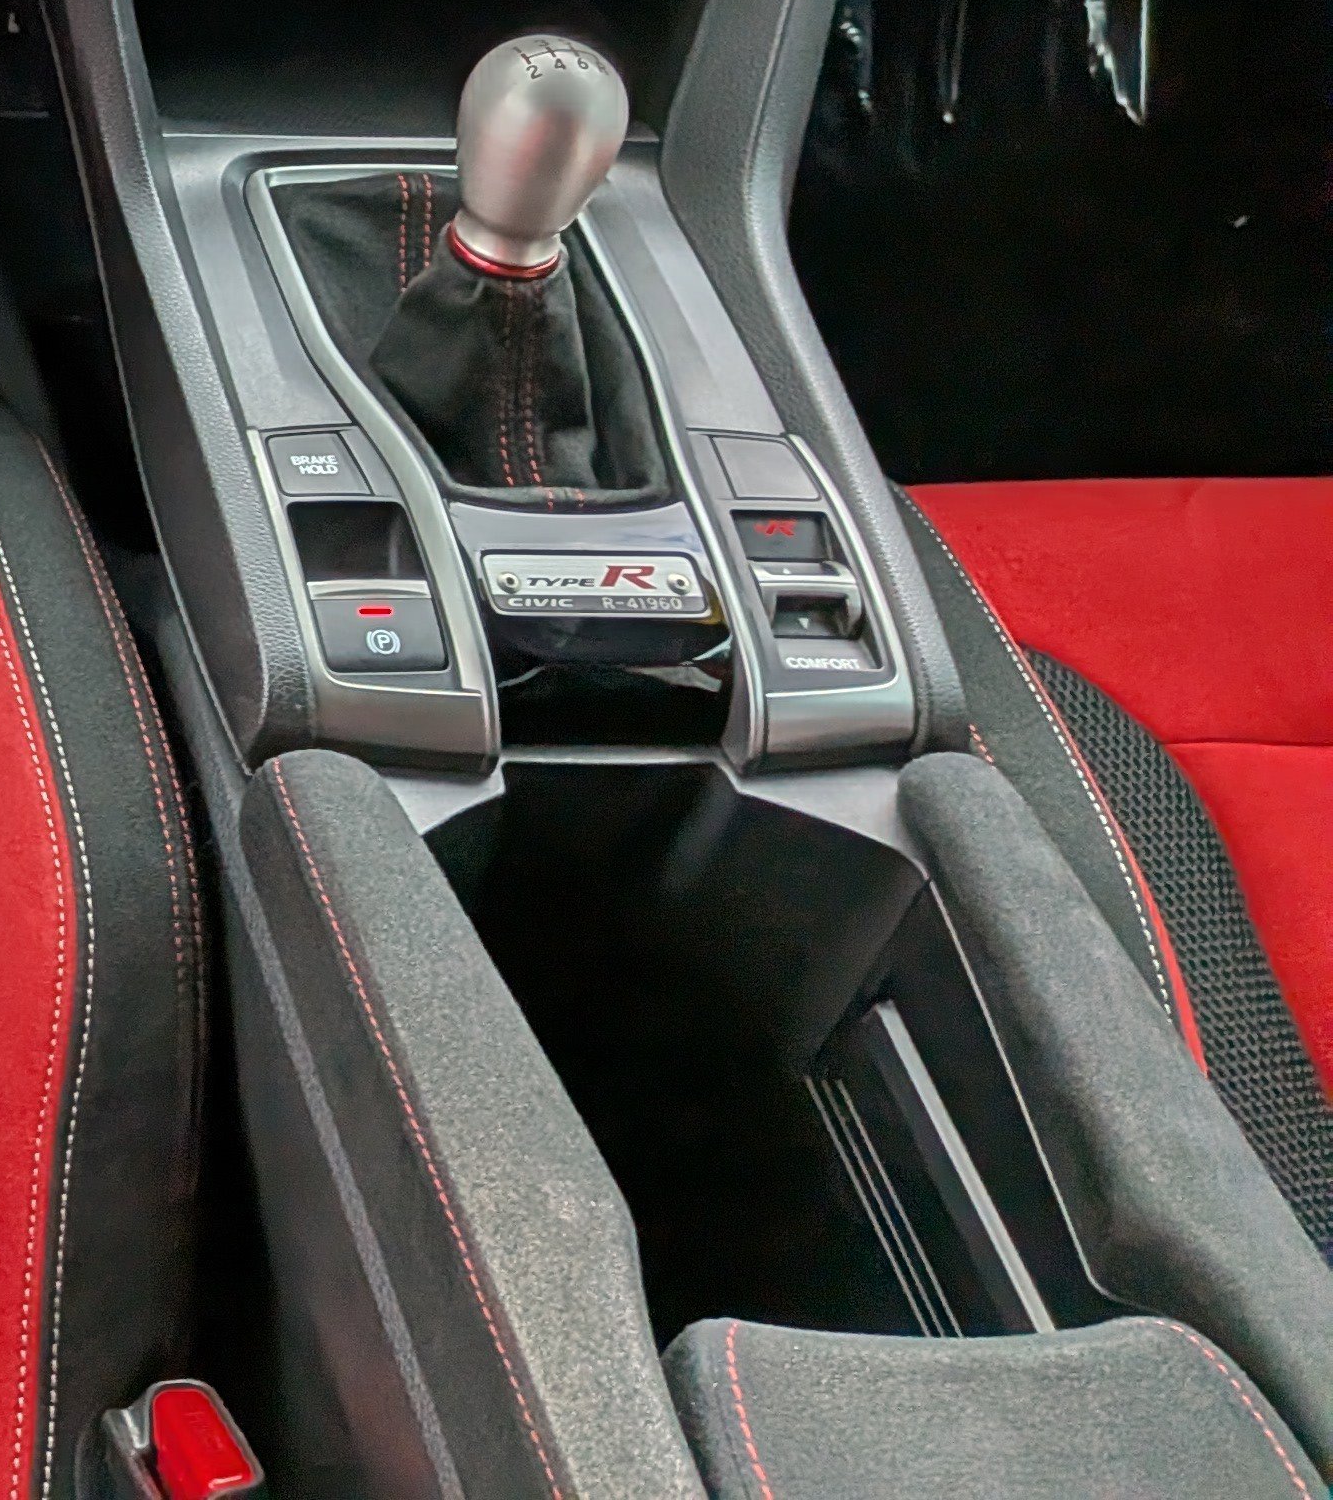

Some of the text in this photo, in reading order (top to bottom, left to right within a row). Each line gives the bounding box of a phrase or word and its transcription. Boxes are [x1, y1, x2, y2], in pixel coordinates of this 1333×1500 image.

[554, 58, 567, 70] 4
[577, 57, 590, 70] 6
[526, 64, 543, 80] 2
[290, 454, 339, 466] BRAKE
[298, 464, 339, 475] HOLD
[526, 564, 658, 590] TYPE R
[506, 596, 683, 611] CIVIC R-41960
[785, 656, 861, 671] COMFORT
